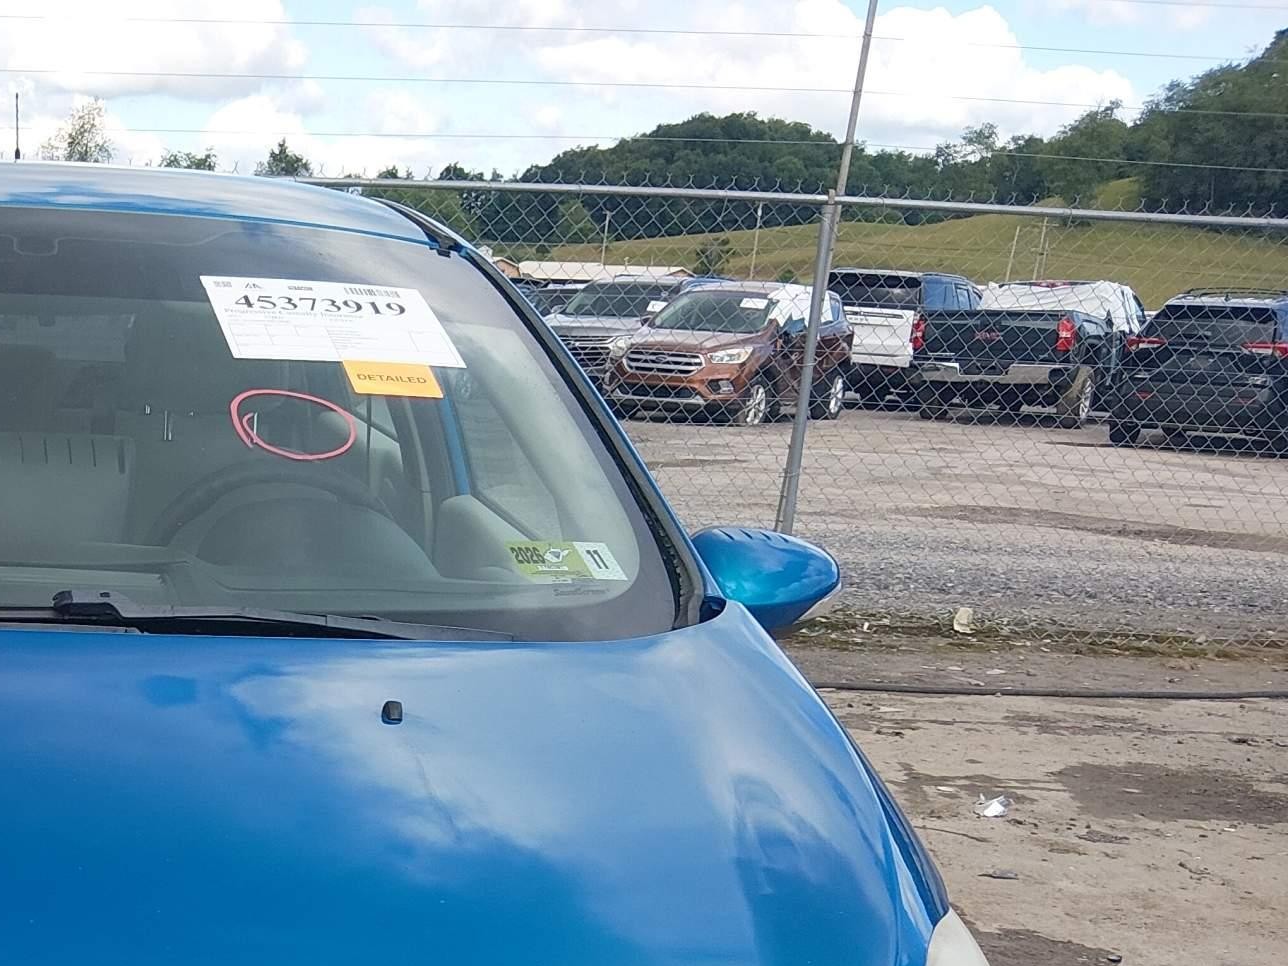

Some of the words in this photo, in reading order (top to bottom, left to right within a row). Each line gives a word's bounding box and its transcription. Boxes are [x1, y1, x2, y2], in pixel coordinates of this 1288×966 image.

[234, 294, 406, 316] 45373919
[357, 373, 427, 385] DETAILED
[510, 546, 546, 565] 2026
[586, 549, 609, 569] 11
